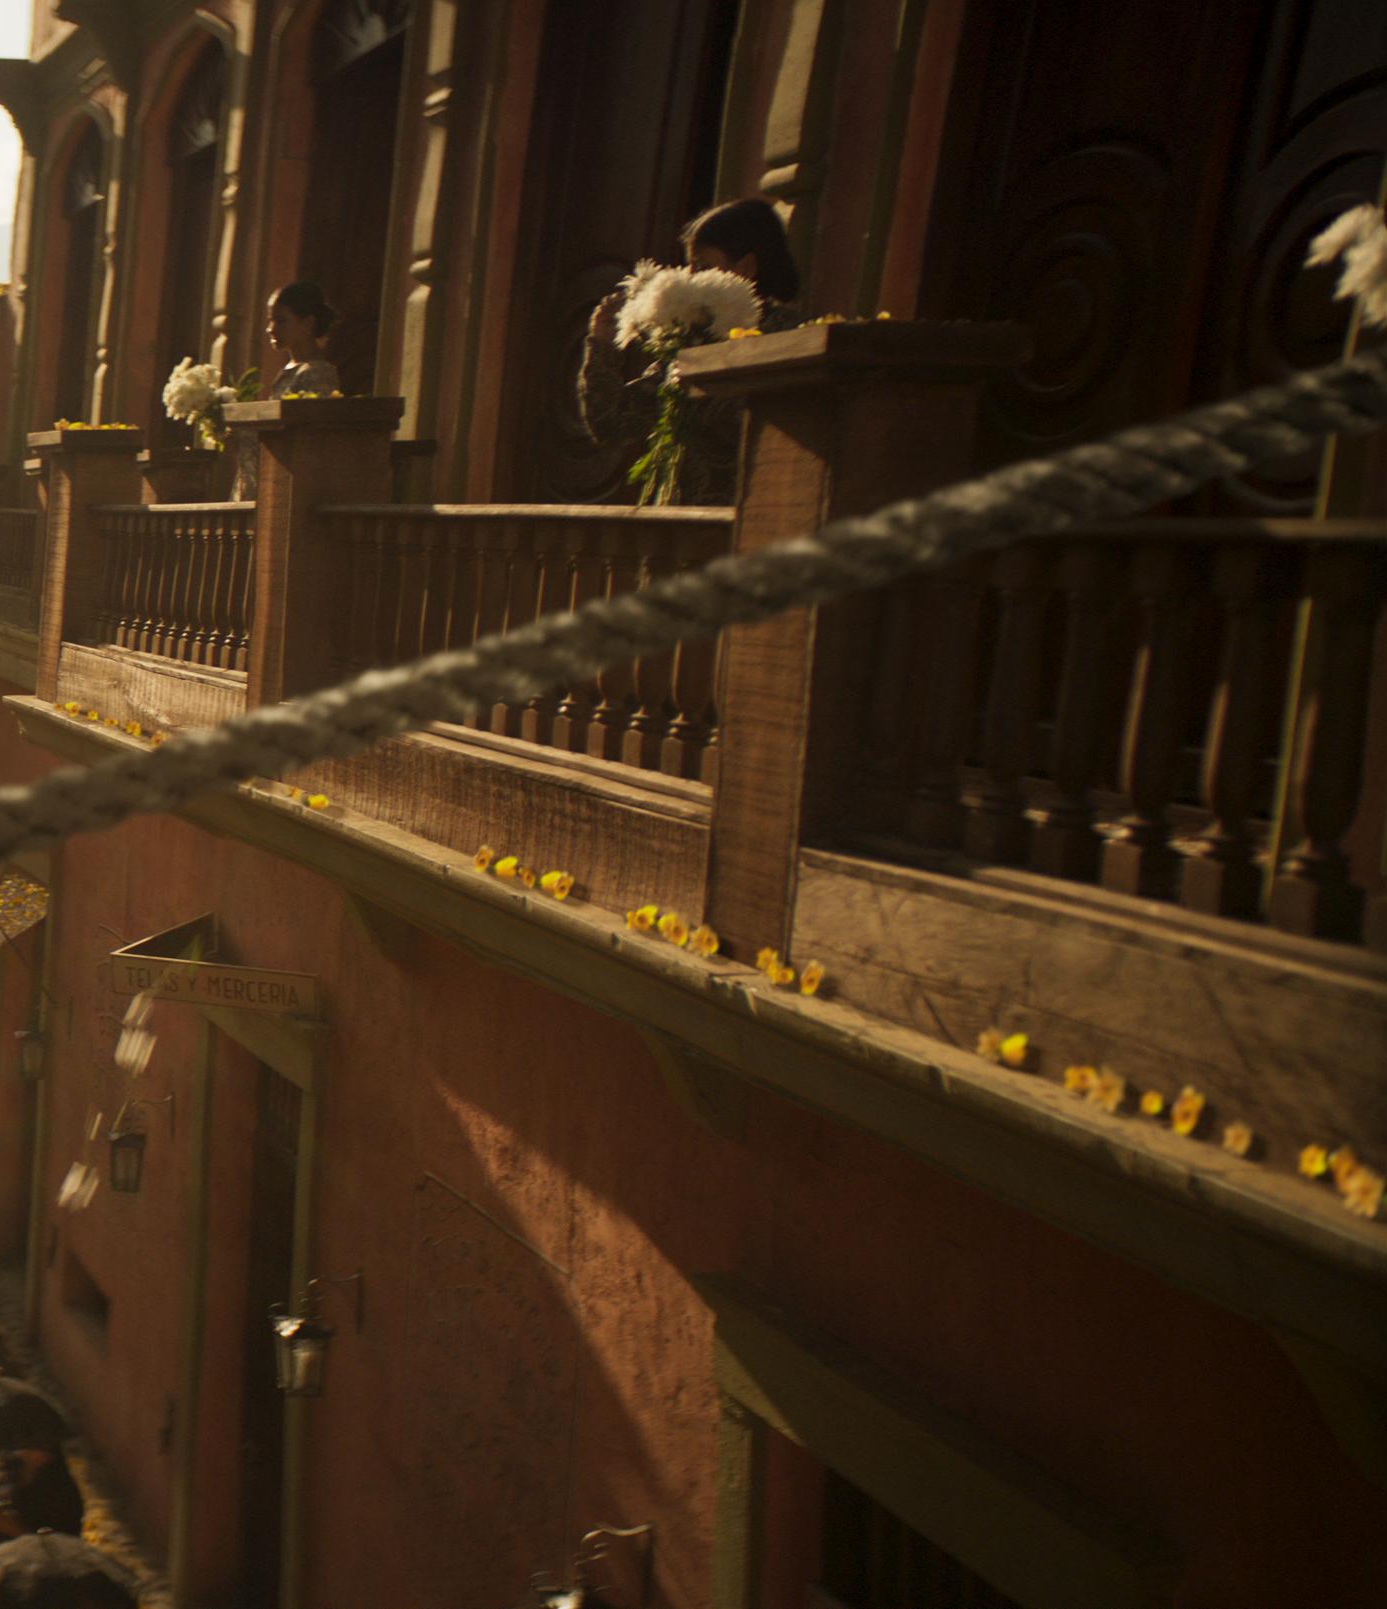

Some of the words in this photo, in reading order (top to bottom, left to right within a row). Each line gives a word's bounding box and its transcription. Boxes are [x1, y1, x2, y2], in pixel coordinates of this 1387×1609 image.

[125, 966, 180, 993] TELS
[188, 975, 199, 993] Y
[208, 976, 300, 1007] MERCERIA
